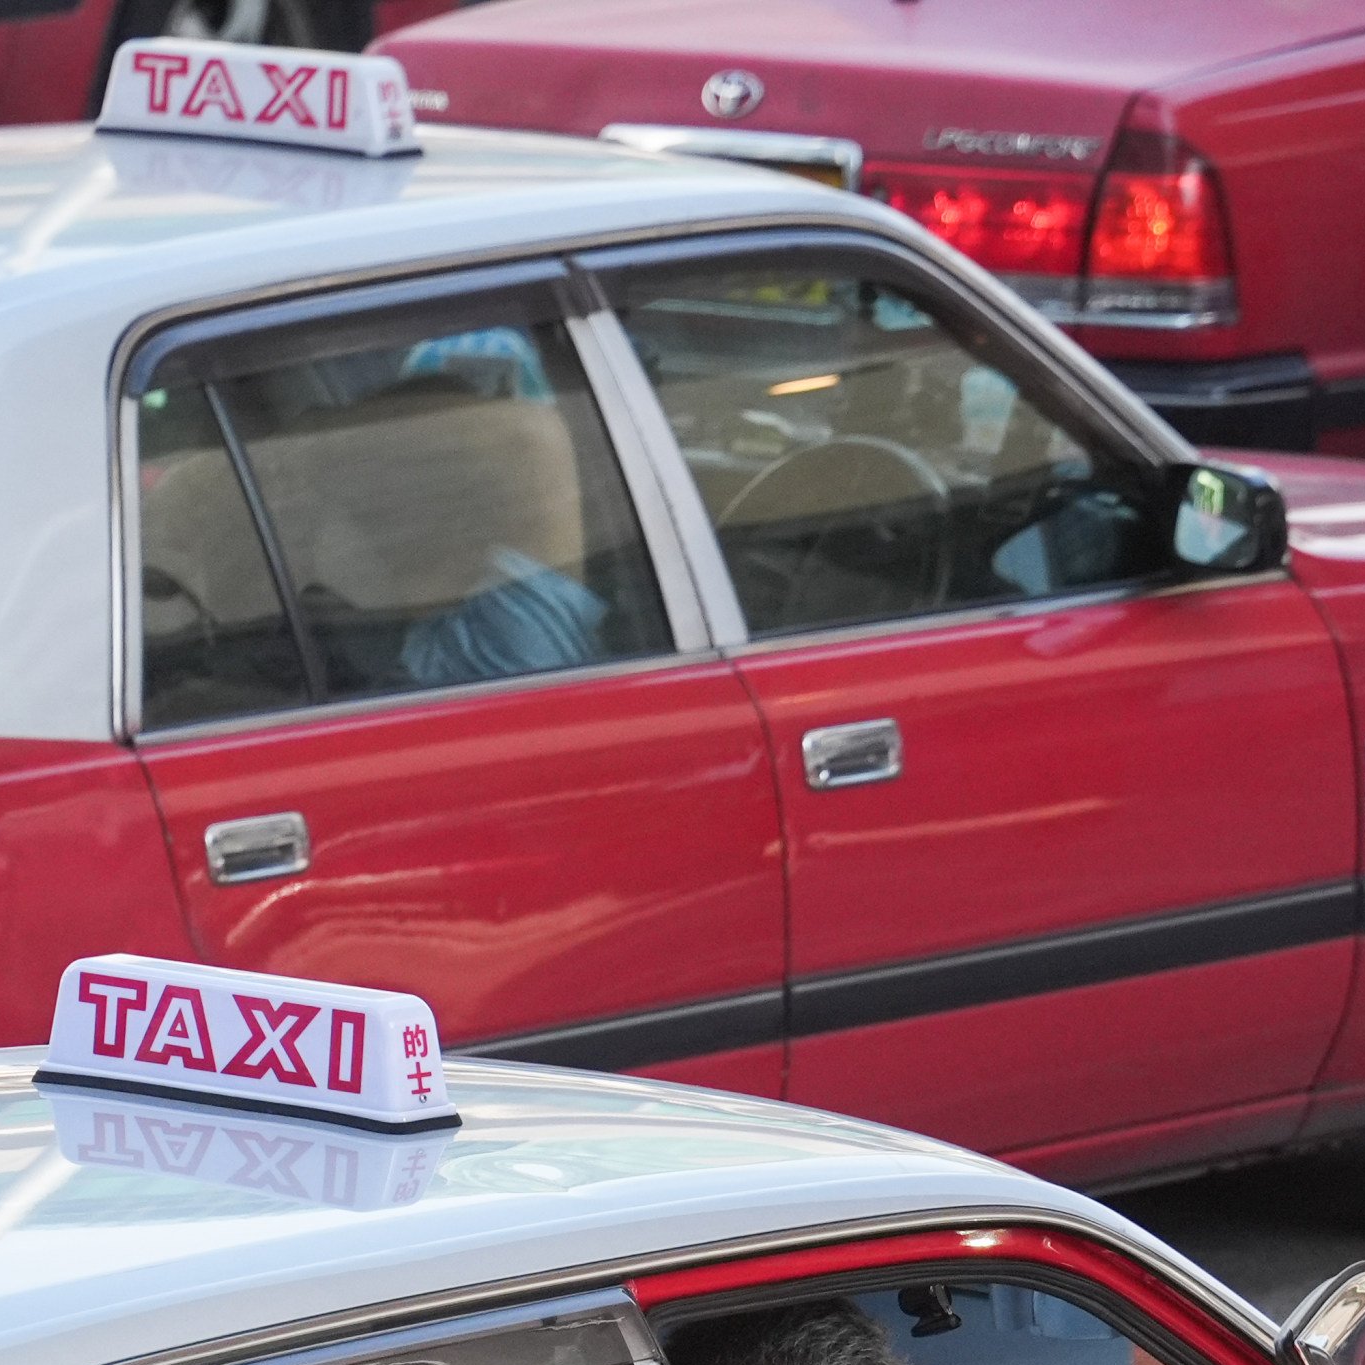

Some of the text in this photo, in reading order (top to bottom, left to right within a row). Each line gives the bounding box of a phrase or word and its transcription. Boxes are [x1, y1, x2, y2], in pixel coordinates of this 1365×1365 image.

[133, 52, 348, 130] TAXI
[78, 971, 366, 1095] TAXI
[402, 1023, 432, 1097] 的士
